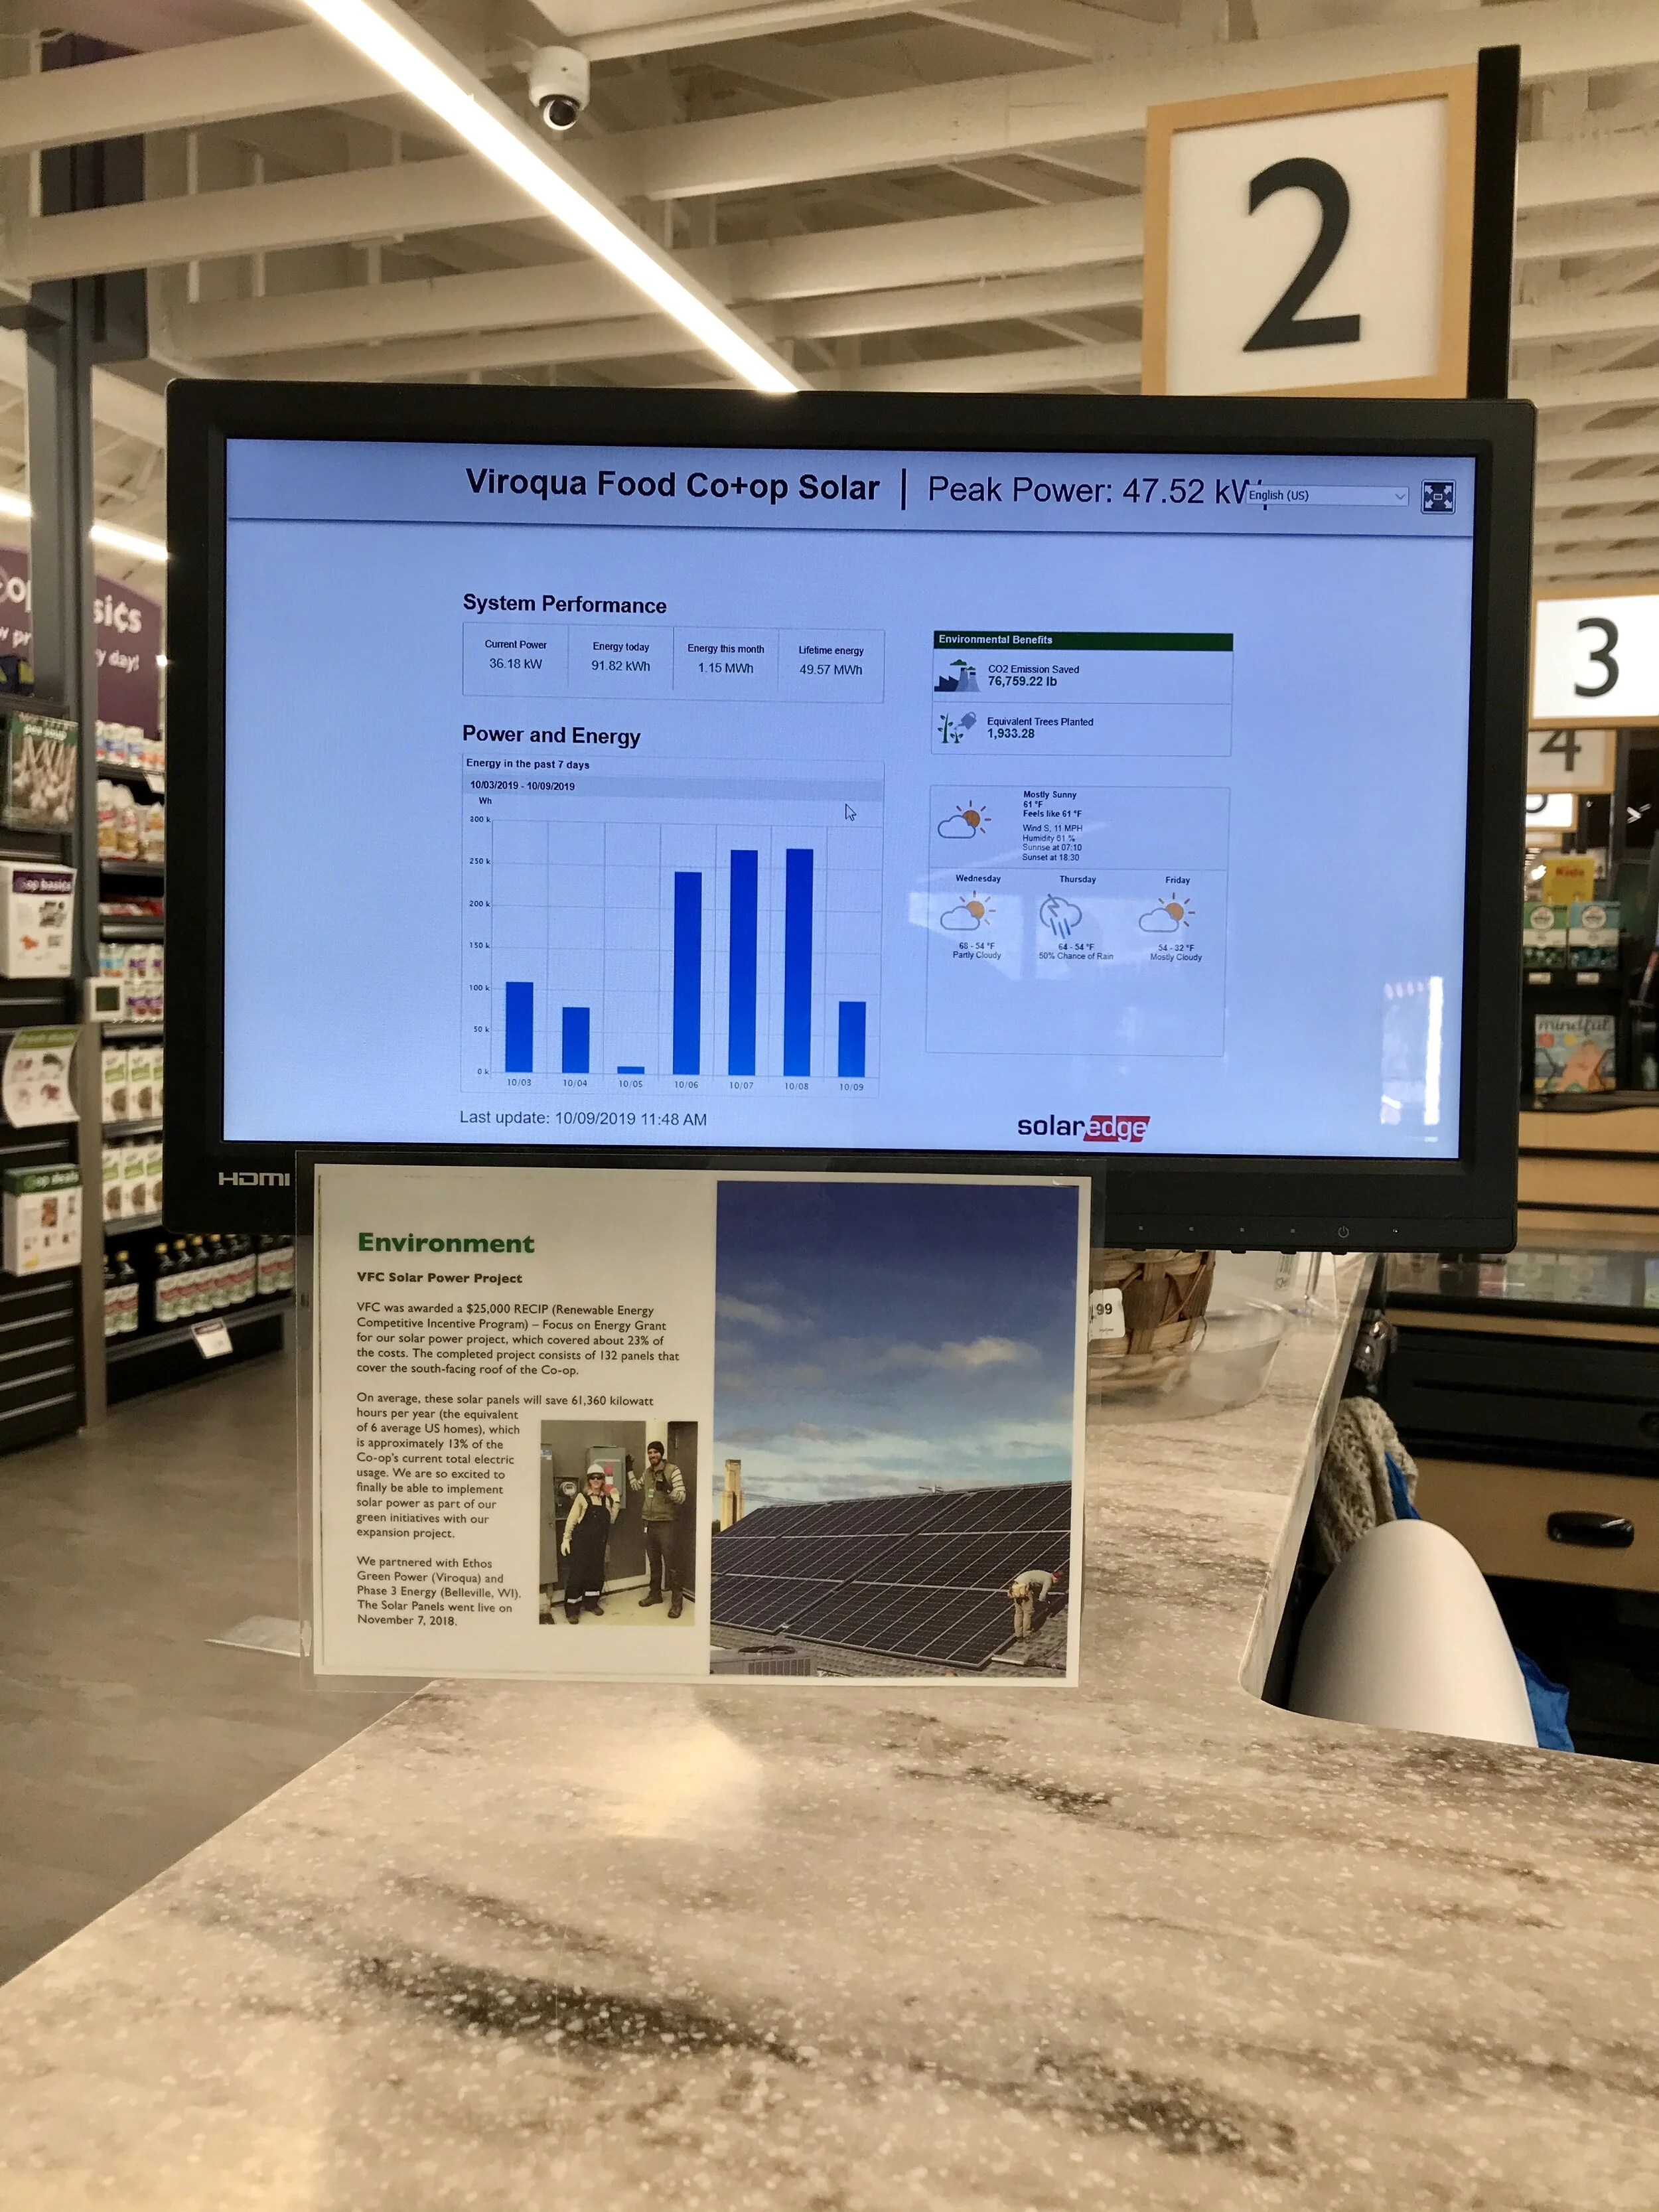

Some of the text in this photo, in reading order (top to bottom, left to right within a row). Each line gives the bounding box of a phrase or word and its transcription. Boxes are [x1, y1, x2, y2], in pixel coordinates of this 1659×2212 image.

[1242, 157, 1360, 352] 2
[465, 467, 881, 506] Viroqua Food Co+op Solar
[929, 475, 1003, 502] Peak
[1013, 477, 1112, 503] Power:
[1122, 478, 1204, 504] 47.52
[1249, 489, 1309, 502] English (US)
[463, 593, 667, 615] System Performance
[484, 639, 547, 649] Current Power
[939, 634, 1053, 644] Environmental Benefits
[593, 641, 650, 653] Energy today
[687, 643, 764, 654] Energy this month
[799, 645, 864, 657] Lifetime energy
[489, 658, 543, 670] 36.18 kW
[1574, 617, 1620, 698] 3
[591, 660, 650, 672] 91.82 kWh
[699, 662, 754, 674] 1.15 MWh
[799, 664, 863, 676] 49.57 MWh
[988, 664, 1080, 674] CO2 Emission Saved
[988, 675, 1057, 688] 76,759.22 lb
[987, 717, 1094, 727] Equivalent Trees Planted
[463, 724, 641, 749] Power and Energy
[987, 728, 1035, 740] 1,933.28
[1540, 730, 1582, 772] 4
[467, 758, 590, 771] Energy in the past 7 days
[478, 796, 492, 805] Wh
[1023, 790, 1077, 800] Mostly Sunny
[956, 874, 1001, 884] Wednesday
[1059, 875, 1097, 885] Thursday
[1165, 876, 1190, 885] Friday
[1538, 1015, 1610, 1037] mindful
[563, 1079, 588, 1088] 10/04
[619, 1080, 643, 1088] 10/05
[675, 1080, 699, 1089] 10/06
[730, 1081, 754, 1090] 10/07
[785, 1082, 809, 1091] 10/08
[840, 1083, 864, 1092] 10/09
[461, 1110, 707, 1128] Last update: 10/09/2019 11:48 AM
[1017, 1115, 1149, 1142] solaredge
[218, 1172, 290, 1187] HDMI
[358, 1232, 535, 1254] Environment
[356, 1272, 523, 1286] VFC Solar Power Project
[356, 1301, 381, 1312] VFC
[407, 1303, 453, 1313] awarded
[467, 1303, 510, 1315] $25,000
[514, 1303, 549, 1314] RECIP
[552, 1304, 614, 1317] (Renewable
[617, 1305, 654, 1318] Energy
[356, 1332, 373, 1342] for
[398, 1333, 425, 1343] solar
[429, 1336, 463, 1346] power
[467, 1334, 508, 1347] project,
[512, 1334, 543, 1345] which
[547, 1335, 590, 1345] covered
[593, 1335, 624, 1345] about
[627, 1335, 650, 1346] 23%
[652, 1335, 664, 1346] of
[356, 1347, 680, 1363] the costs. The completed project consists of 132 panels that
[390, 1363, 407, 1373] the
[411, 1363, 476, 1377] south-facing
[479, 1364, 504, 1374] roof
[506, 1364, 518, 1374] of
[520, 1364, 538, 1374] the
[541, 1364, 579, 1378] Co-op.
[356, 1392, 374, 1402] On
[378, 1395, 421, 1406] average,
[424, 1393, 453, 1404] these
[457, 1394, 484, 1404] solar
[486, 1394, 520, 1407] panels
[523, 1394, 541, 1405] will
[571, 1395, 607, 1406] 61,360
[610, 1396, 654, 1406] kilowatt
[356, 1556, 492, 1569] We partnered with Ethos
[357, 1585, 521, 1601] Phase 3 Energy (Belleville, WI).
[358, 1613, 457, 1626] November 7, 2018.
